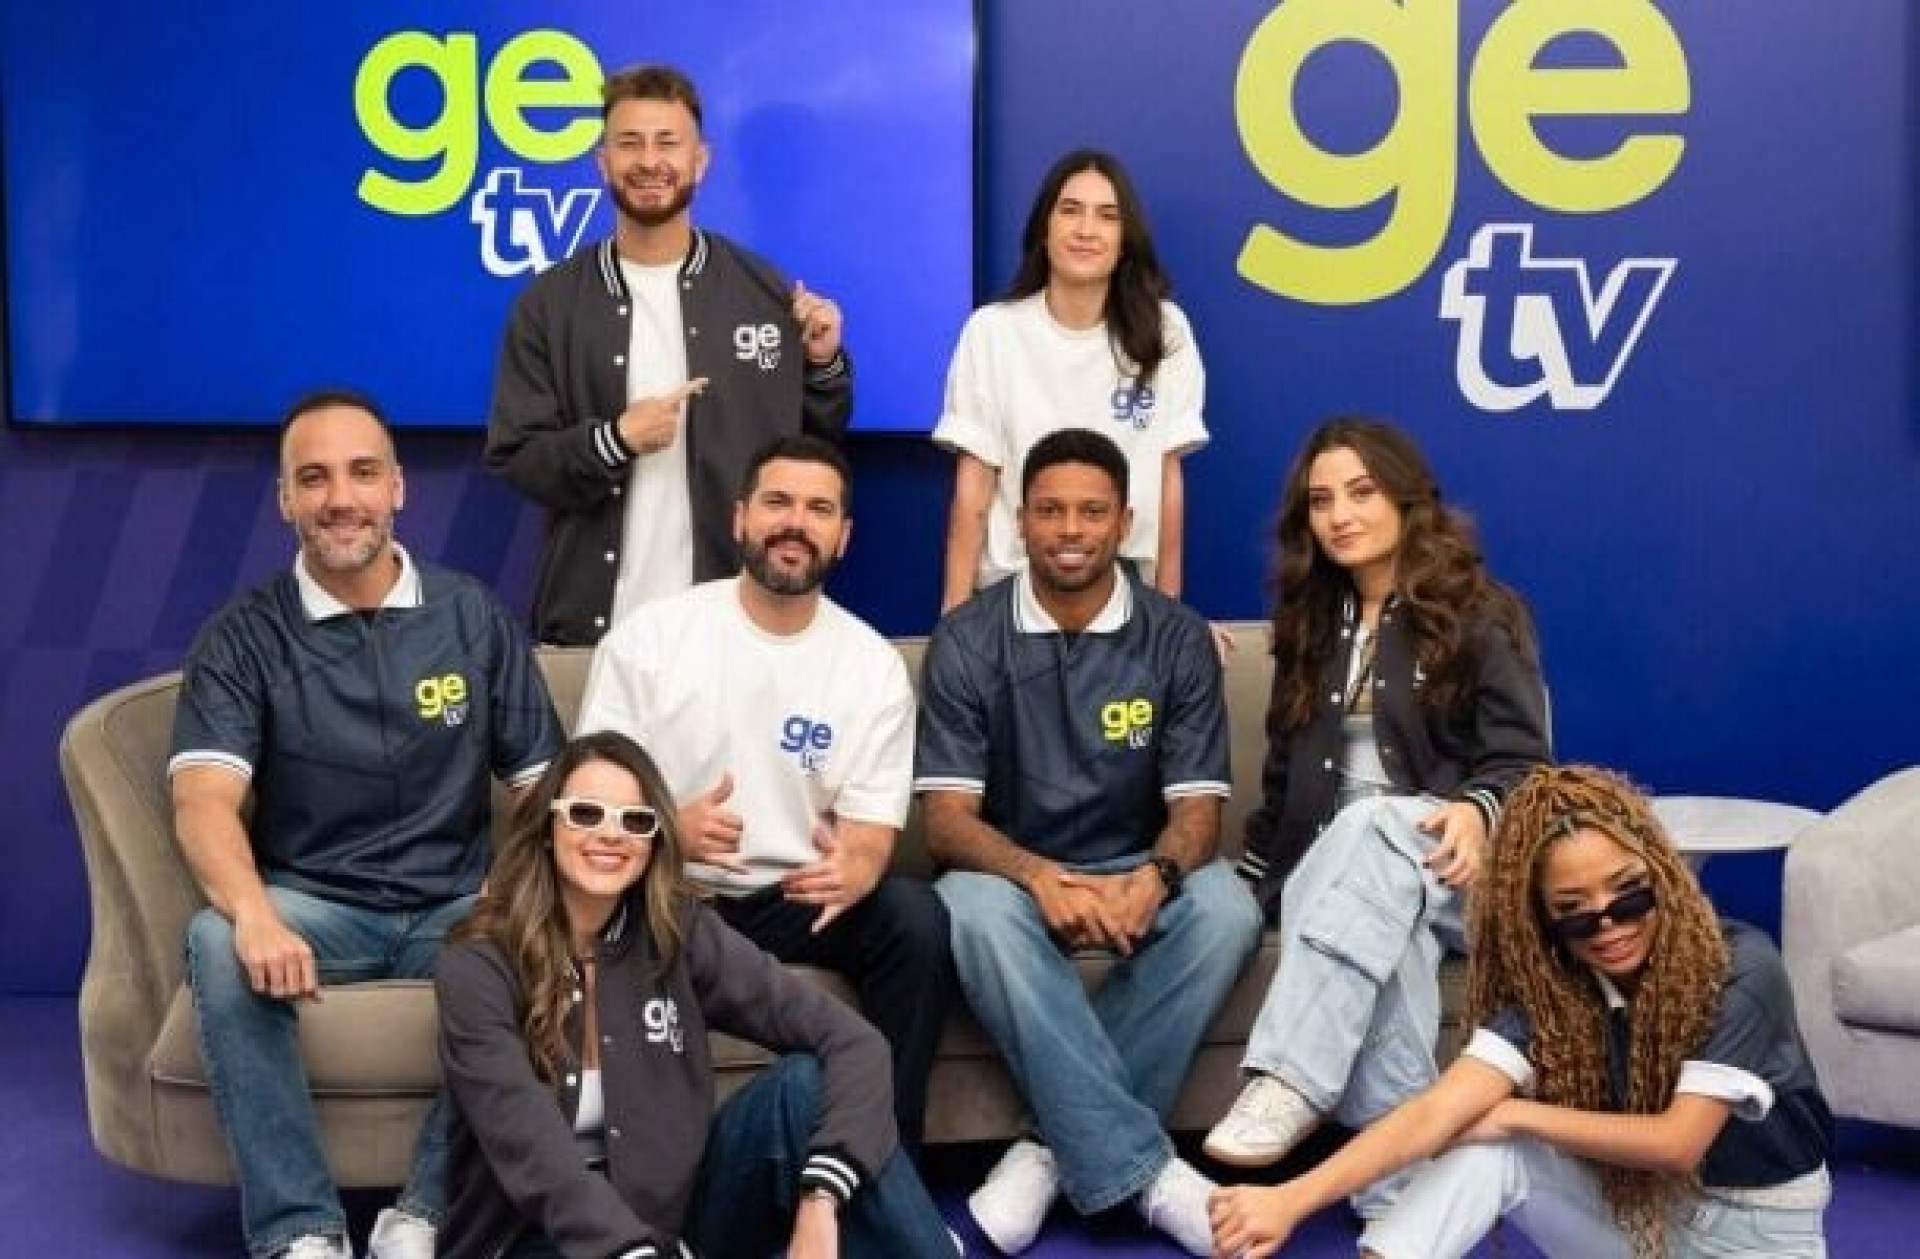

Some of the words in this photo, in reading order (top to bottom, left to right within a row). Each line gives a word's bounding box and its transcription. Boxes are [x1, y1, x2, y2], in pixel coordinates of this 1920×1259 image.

[355, 30, 605, 216] ge
[1234, 0, 1691, 305] ge
[471, 167, 602, 277] tv
[733, 324, 781, 360] ge
[1438, 222, 1678, 413] tv
[415, 673, 467, 719] ge
[780, 714, 832, 753] ge
[1101, 699, 1153, 741] ge
